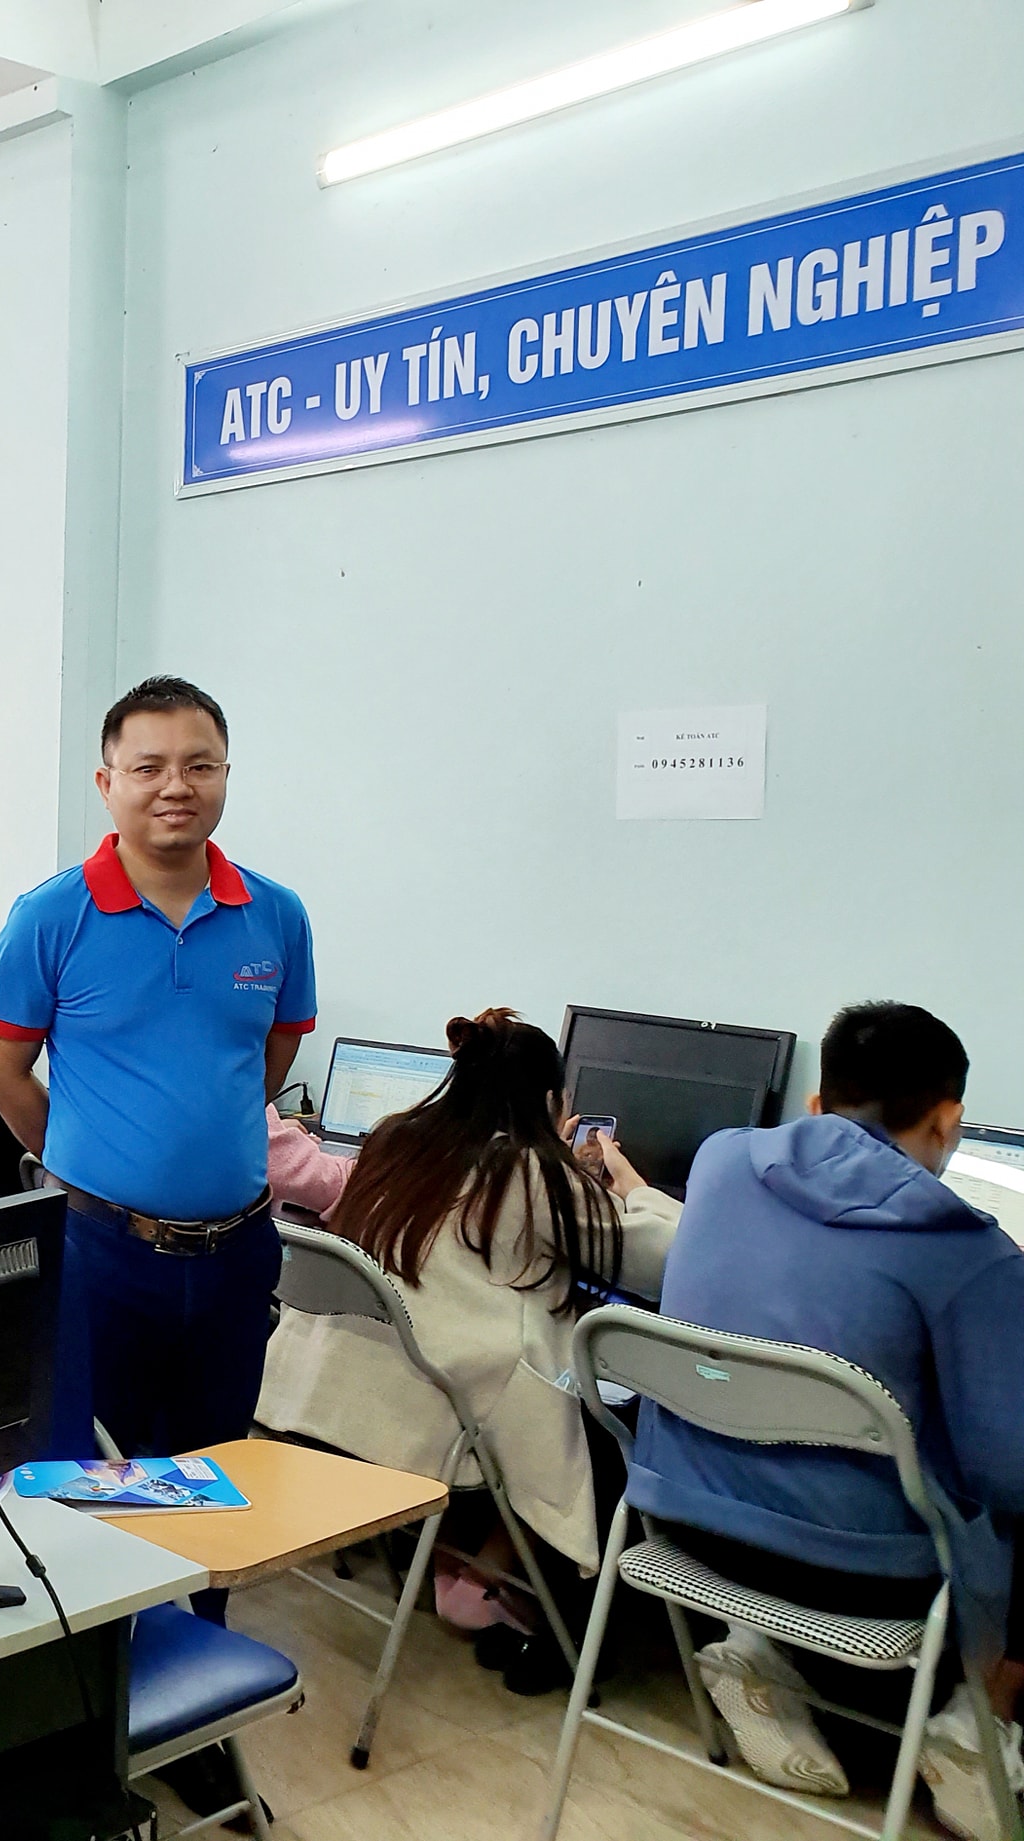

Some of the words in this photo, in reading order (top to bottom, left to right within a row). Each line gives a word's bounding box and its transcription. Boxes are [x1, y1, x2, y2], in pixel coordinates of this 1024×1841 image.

[220, 375, 292, 445] ATC
[305, 394, 322, 410] -
[334, 354, 391, 421] UY
[403, 325, 490, 406] TÍN,
[506, 271, 727, 381] CHUYÊN
[747, 204, 1006, 337] NGHIỆP
[239, 960, 272, 977] ATC
